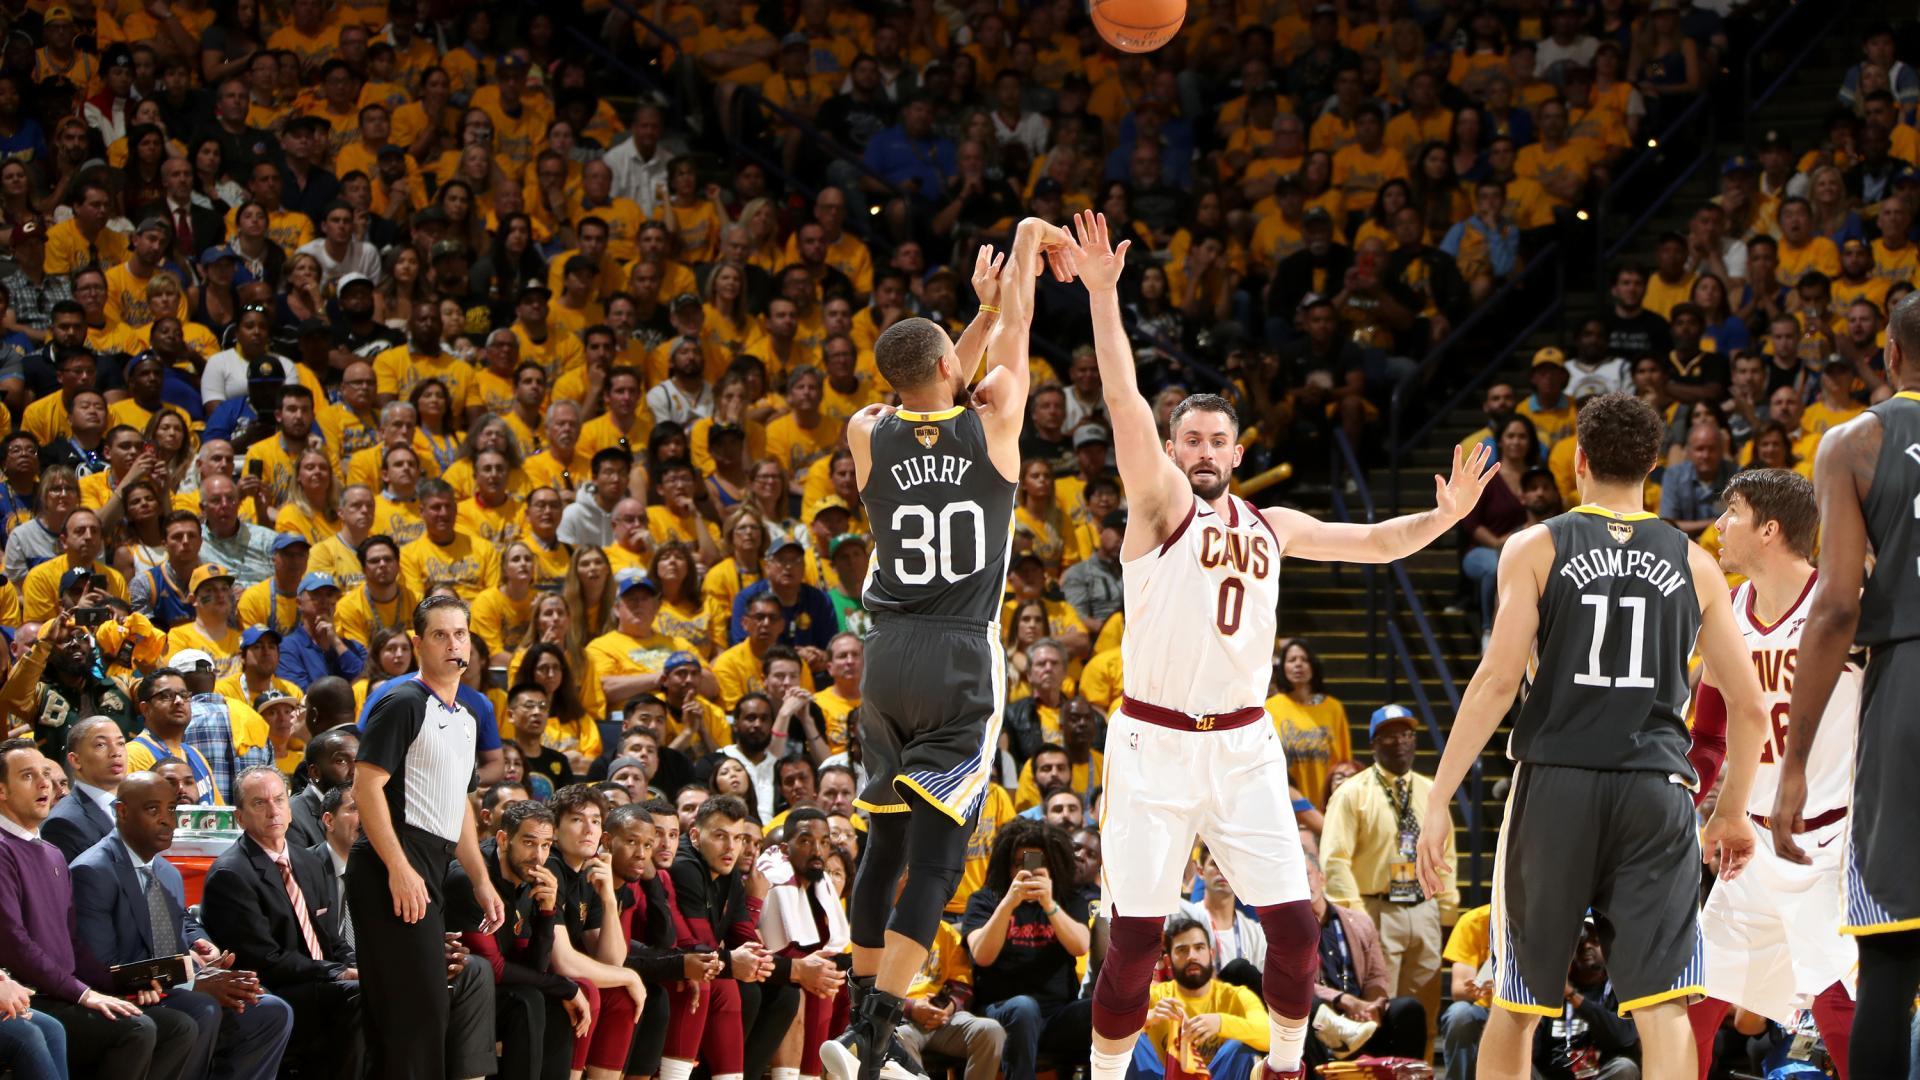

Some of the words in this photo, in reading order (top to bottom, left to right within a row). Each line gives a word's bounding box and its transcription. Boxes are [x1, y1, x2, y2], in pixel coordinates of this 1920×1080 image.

[890, 454, 973, 491] CURRY
[891, 500, 986, 585] 30
[1200, 525, 1270, 580] CAVS
[1560, 548, 1686, 597] THOMPSON
[1216, 575, 1246, 637] 0
[1573, 594, 1655, 688] 11
[1751, 648, 1799, 694] AVS
[40, 689, 70, 727] B
[1196, 717, 1216, 731] CLE
